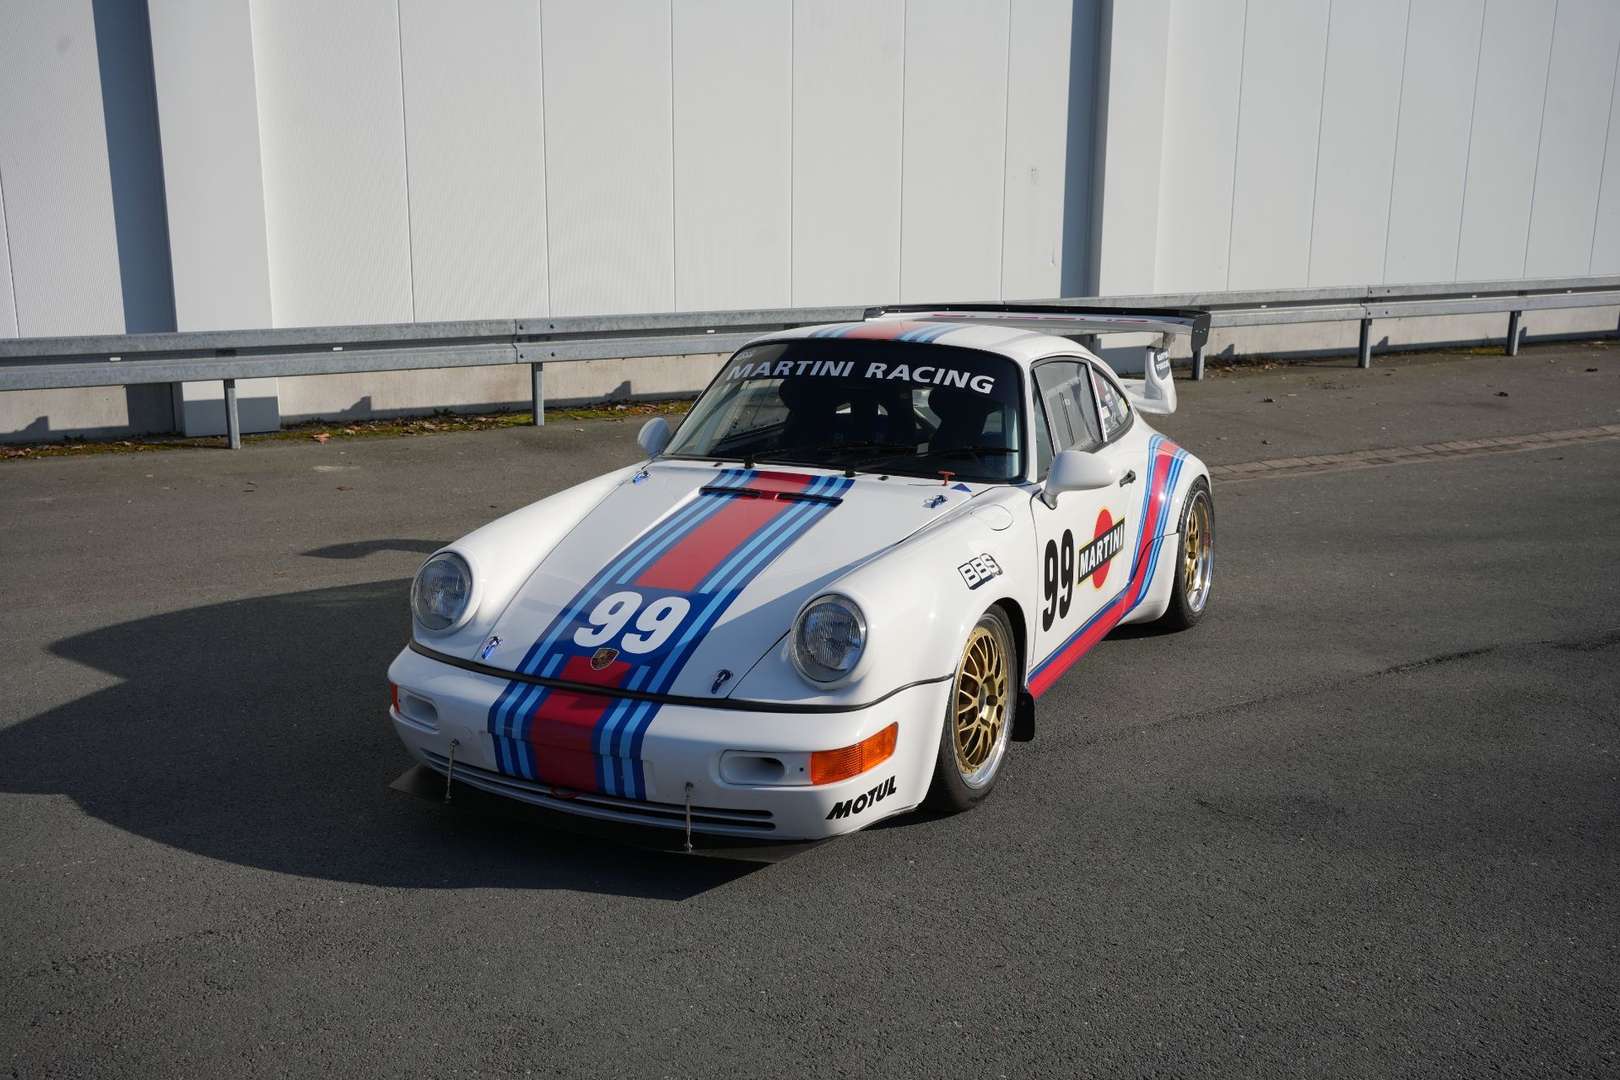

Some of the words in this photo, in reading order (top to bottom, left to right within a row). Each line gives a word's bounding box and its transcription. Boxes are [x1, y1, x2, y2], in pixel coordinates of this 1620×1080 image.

[727, 360, 854, 380] MARTINI
[865, 362, 995, 394] RACING
[957, 552, 1003, 590] BBS
[1080, 523, 1124, 578] MARTINI
[1042, 529, 1074, 632] 99
[573, 591, 691, 655] 99
[825, 775, 897, 820] MOTUL
